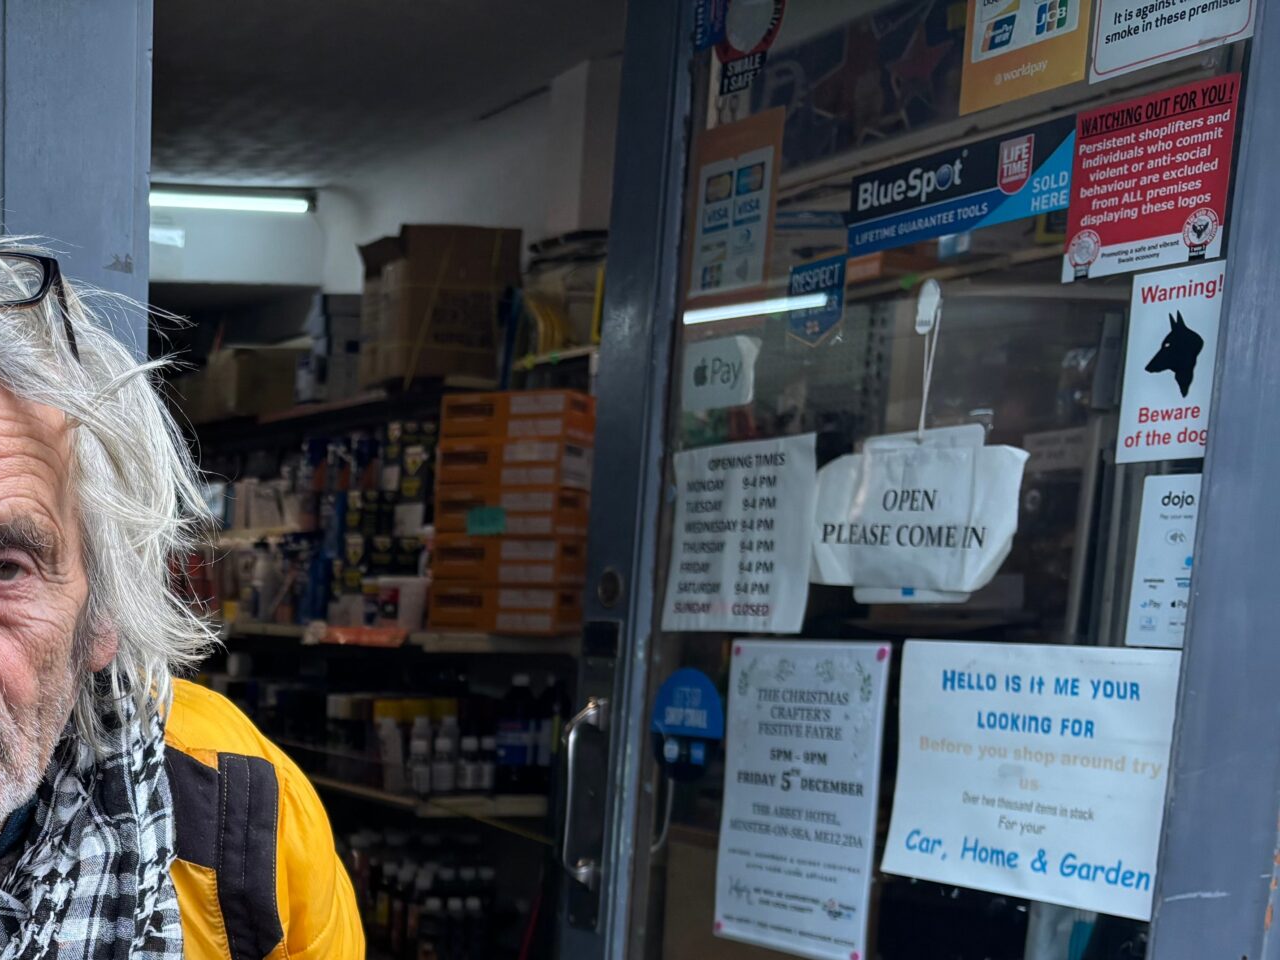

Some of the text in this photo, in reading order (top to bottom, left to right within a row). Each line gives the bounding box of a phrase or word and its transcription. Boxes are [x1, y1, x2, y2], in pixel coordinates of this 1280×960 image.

[1036, 7, 1068, 26] JCB
[1105, 25, 1139, 44] smoke
[1142, 20, 1152, 32] in
[1155, 10, 1186, 28] these
[1114, 12, 1122, 25] It
[1124, 9, 1133, 21] is
[1082, 105, 1142, 136] WATCHING
[1146, 98, 1170, 119] OUT
[1174, 91, 1197, 112] FOR
[1078, 109, 1231, 155] Persistent shoplifters and
[1003, 143, 1030, 163] LIFE
[1082, 127, 1223, 169] individuals who commit
[1003, 159, 1028, 177] TIME
[1089, 144, 1212, 182] violent or anti-social
[857, 158, 963, 212] BlueSpot
[1032, 171, 1069, 193] SOLD
[1080, 158, 1219, 198] behaviour are excluded
[1031, 190, 1069, 212] HERE
[1091, 178, 1202, 210] from ALL premises
[1080, 191, 1212, 227] displaying these logos
[855, 202, 988, 245] LIFETIME GUARANTEE TOOLS
[1101, 248, 1129, 258] Promoting
[1134, 245, 1147, 253] safe
[1147, 243, 1158, 251] and
[1159, 240, 1180, 249] vibrant
[1135, 252, 1160, 261] economy
[792, 262, 841, 294] RESPECT
[1141, 274, 1224, 304] Warning!
[711, 356, 743, 390] Pay
[1138, 406, 1201, 424] Beware
[1124, 427, 1208, 448] of the dog
[708, 452, 785, 471] OPENING TIMES
[687, 480, 725, 493] MONDAY
[759, 475, 777, 488] PM
[686, 500, 723, 513] TUESDAY
[759, 497, 777, 509] PM
[882, 489, 938, 512] OPEN
[1161, 490, 1195, 509] dojo
[685, 519, 738, 534] WEDNESDAY
[756, 518, 775, 530] PM
[822, 523, 987, 549] PLEASE COME IN
[682, 541, 726, 554] THURSDAY
[756, 539, 775, 552] PM
[680, 561, 712, 574] FRIDAY
[755, 561, 774, 573] PM
[677, 582, 721, 594] SATURDAY
[750, 582, 770, 594] PM
[673, 602, 769, 617] SUNDAY CLOSED
[942, 669, 997, 692] HELLO
[1005, 675, 1022, 693] IS
[1054, 677, 1080, 696] ME
[1090, 679, 1141, 701] YOUR
[757, 689, 850, 706] THE CHRISTMAS
[770, 705, 832, 723] CRAFTER'S
[758, 722, 843, 741] FESTIVE FAYRE
[1060, 718, 1095, 739] FOR
[770, 748, 792, 762] 5PM
[803, 752, 828, 766] 9PM
[919, 736, 1163, 780] Before you shop around try
[737, 770, 776, 787] FRIDAY
[800, 777, 864, 797] DECEMBER
[1019, 777, 1040, 791] us
[752, 802, 771, 816] THE
[962, 791, 1095, 821] Over two thousand items in stock
[998, 815, 1046, 836] For your
[905, 829, 1151, 891] Car, Home & Garden
